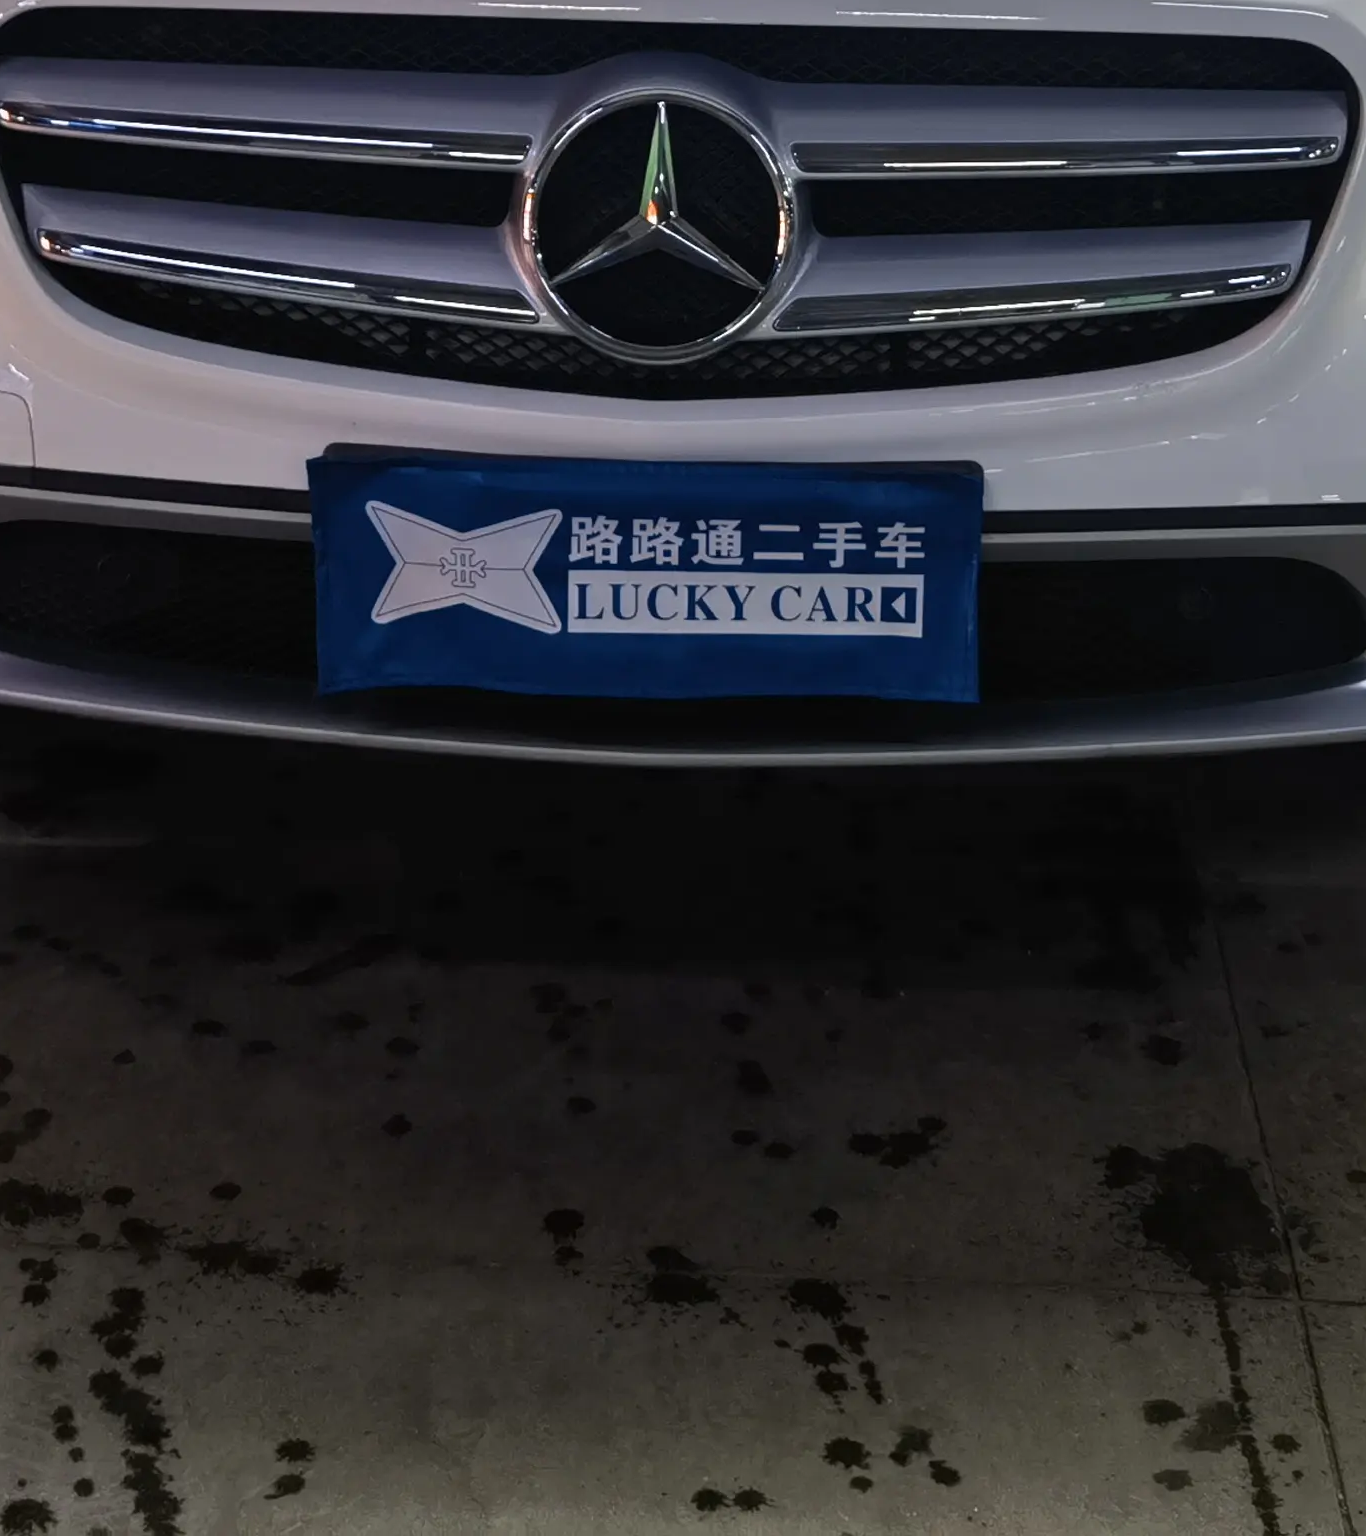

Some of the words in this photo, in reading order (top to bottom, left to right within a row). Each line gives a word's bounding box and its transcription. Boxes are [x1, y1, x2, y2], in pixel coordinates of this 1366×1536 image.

[569, 514, 927, 569] 路路通二手车
[573, 582, 755, 623] LUCKY
[770, 584, 876, 624] CAR
